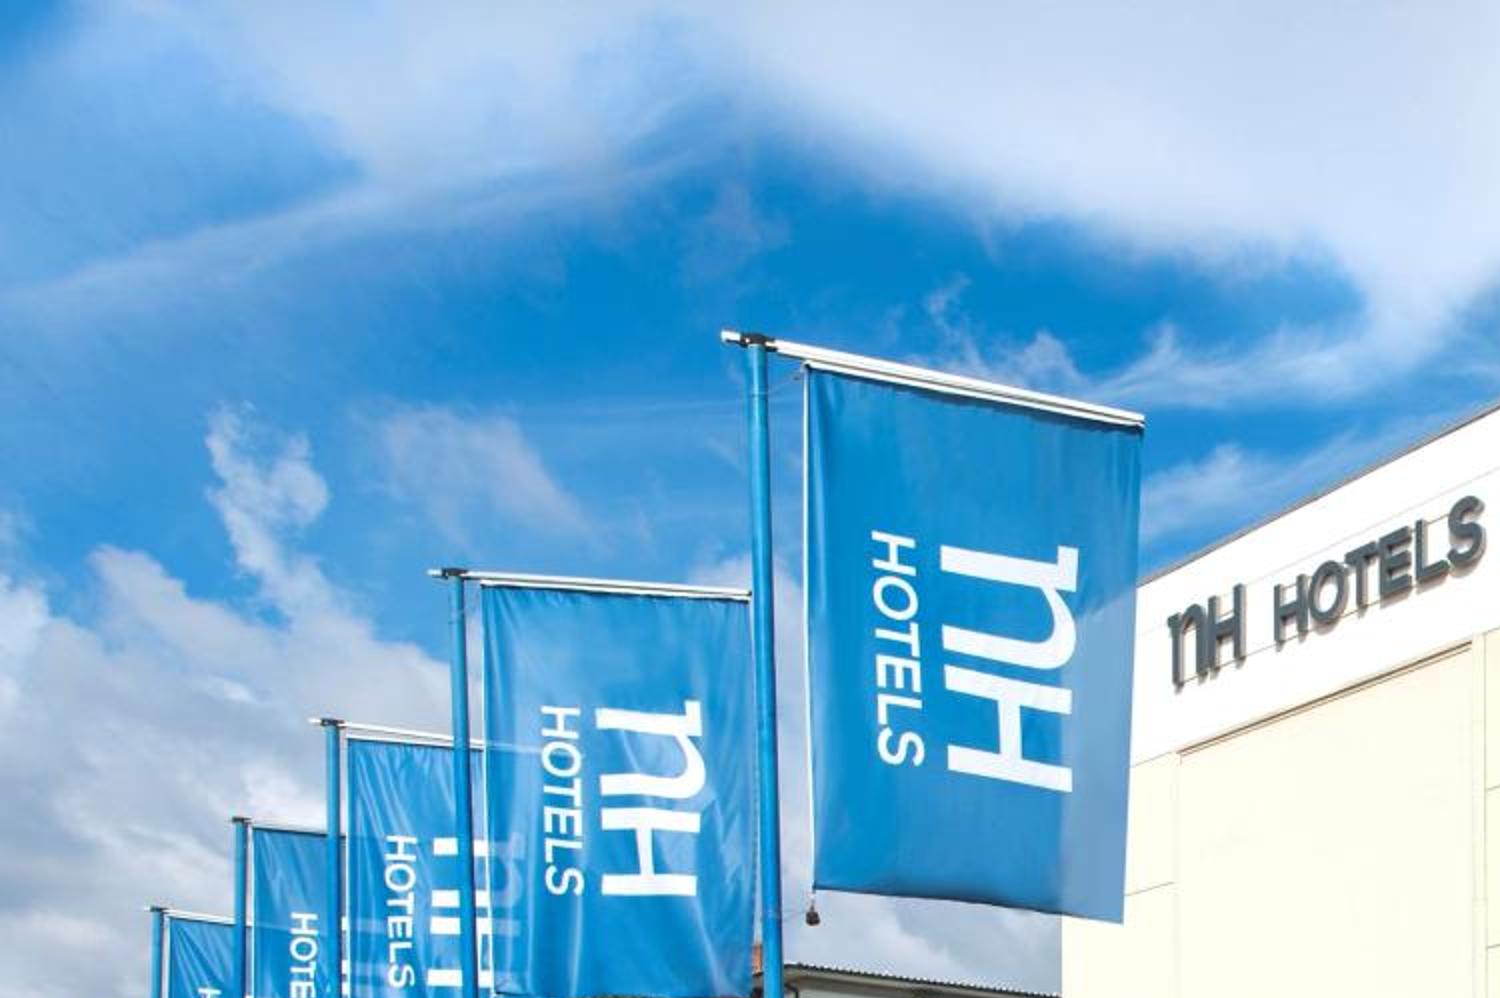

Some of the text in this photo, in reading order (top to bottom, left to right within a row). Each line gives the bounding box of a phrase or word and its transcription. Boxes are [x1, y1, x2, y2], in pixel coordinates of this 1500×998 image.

[871, 530, 925, 767] HOTELS
[1273, 495, 1485, 648] HOTELS
[540, 705, 585, 896] HOTELS
[384, 835, 418, 990] HOTELS
